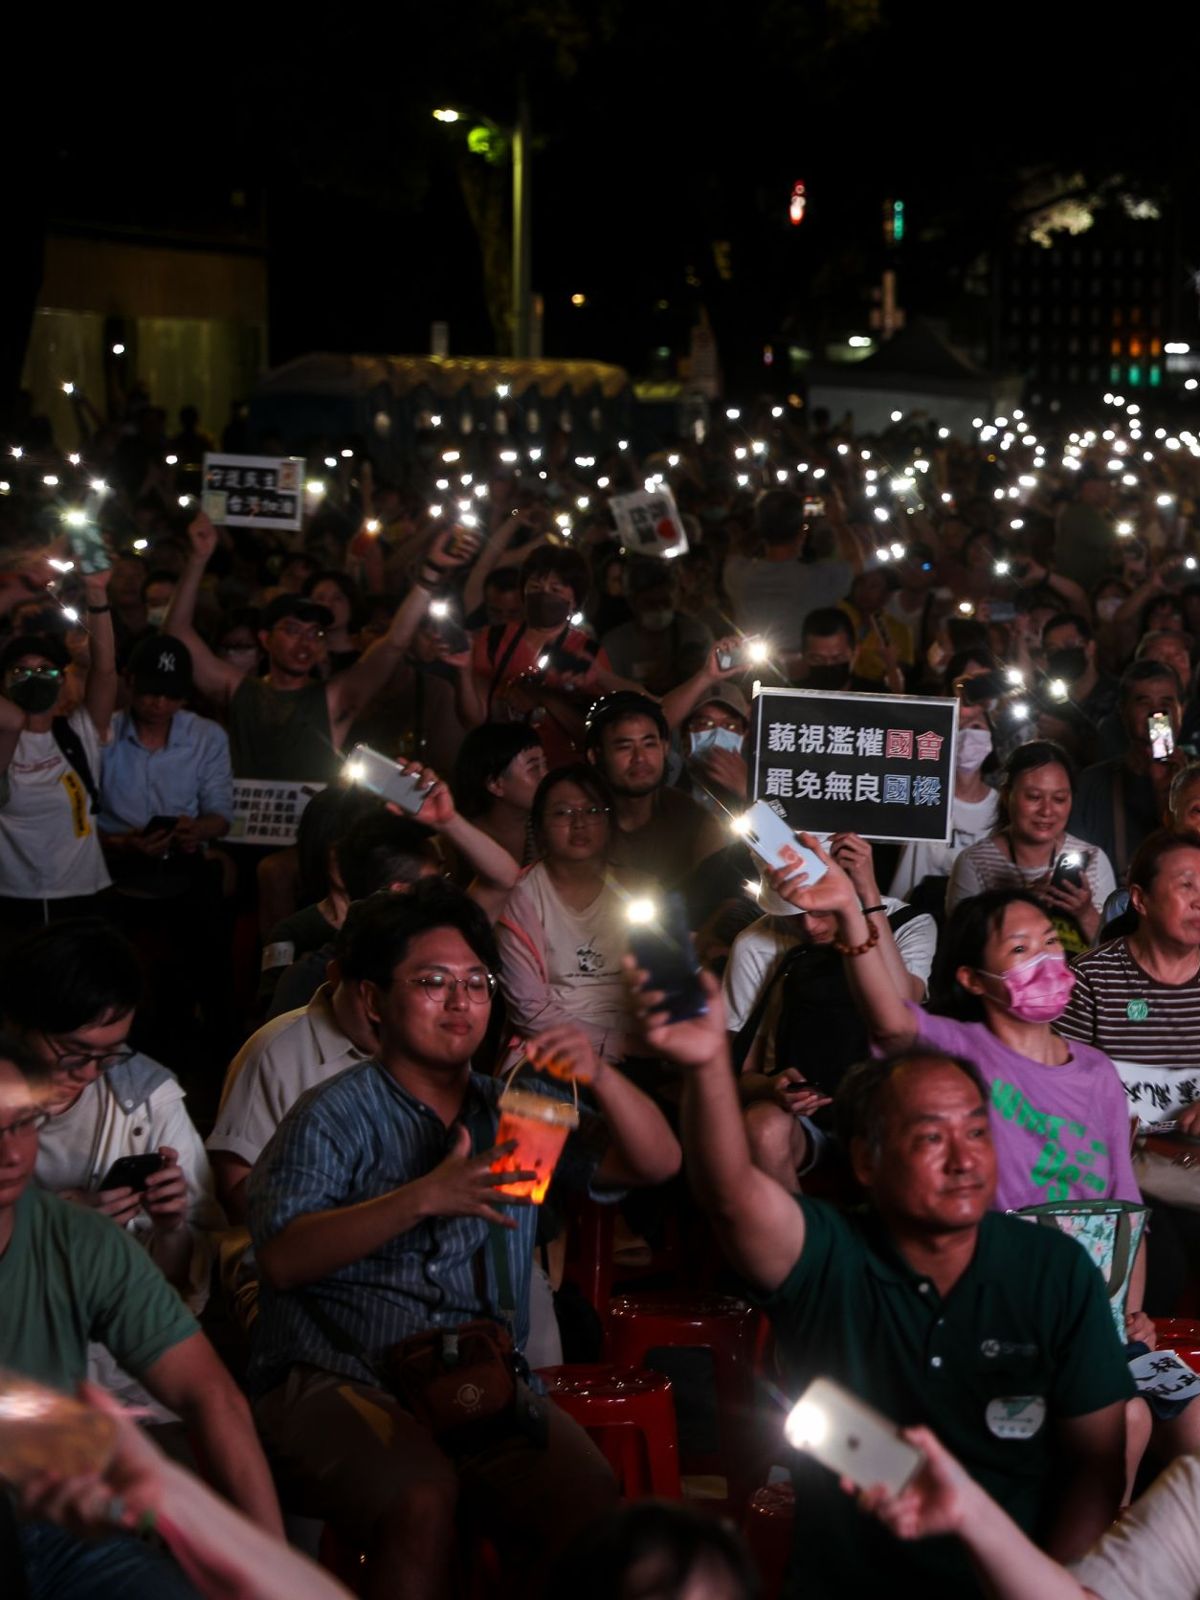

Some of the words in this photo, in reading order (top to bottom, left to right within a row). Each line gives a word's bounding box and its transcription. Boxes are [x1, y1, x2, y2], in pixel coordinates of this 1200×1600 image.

[768, 722, 944, 761] 藐視濫權國會
[765, 767, 941, 806] 罷免無良國樑
